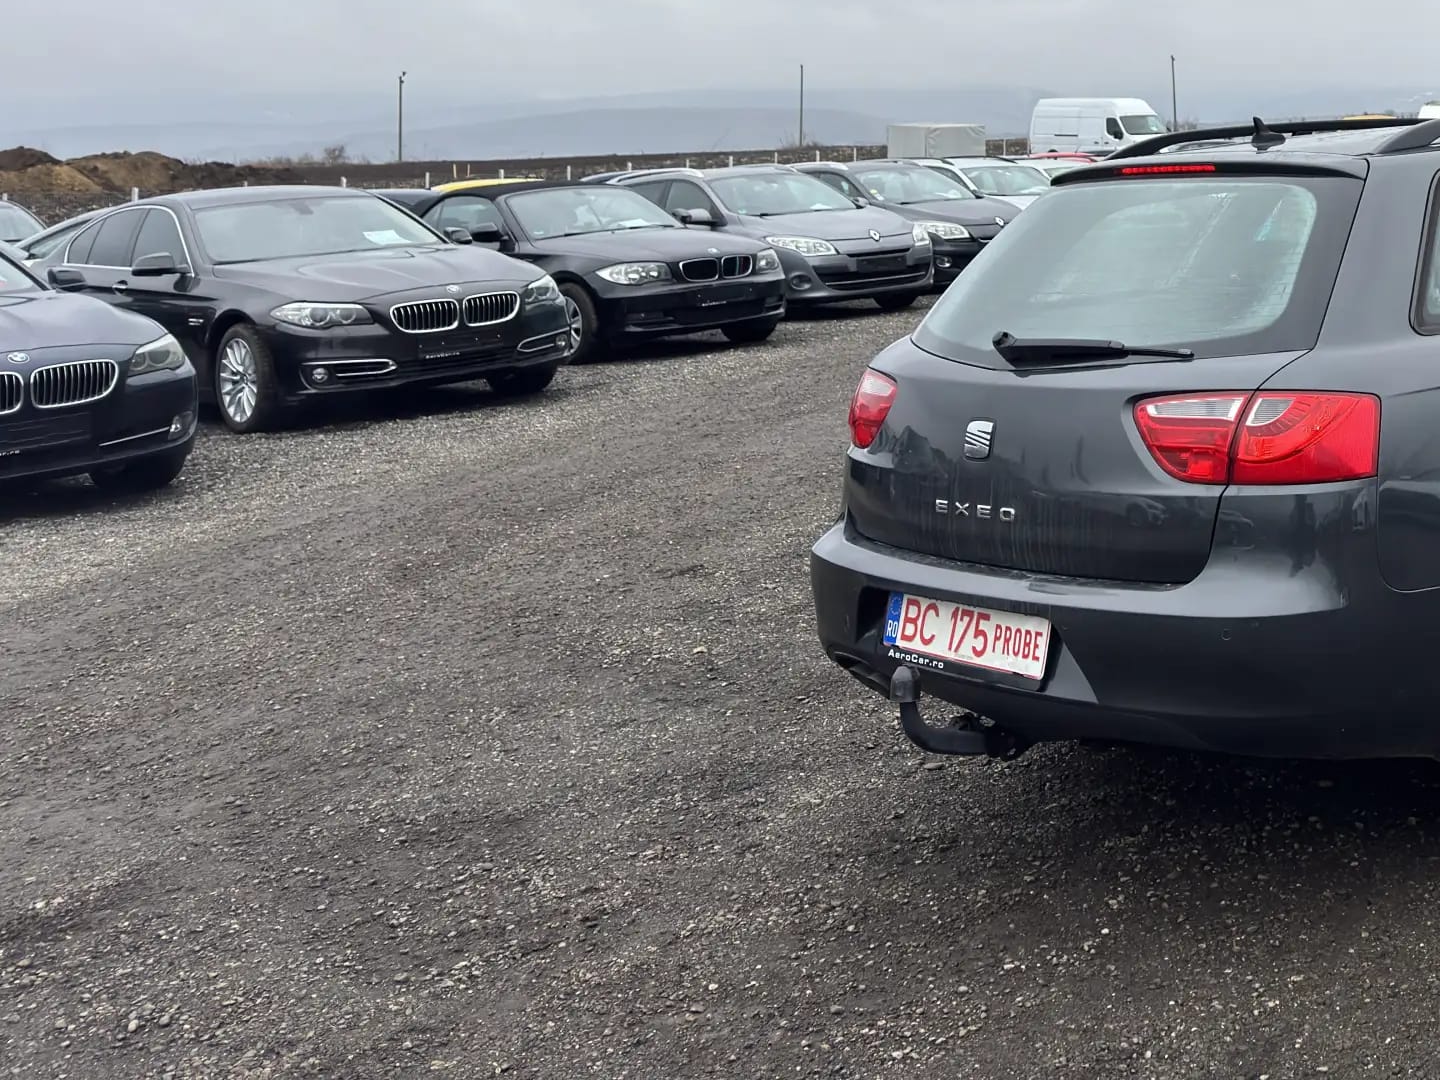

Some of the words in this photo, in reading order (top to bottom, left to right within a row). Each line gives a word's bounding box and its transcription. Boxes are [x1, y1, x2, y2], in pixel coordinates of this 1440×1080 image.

[935, 499, 1016, 522] EXEO
[886, 619, 899, 638] RO
[900, 598, 940, 646] BC
[948, 606, 991, 658] 175
[992, 623, 1043, 662] PROBE
[888, 649, 944, 669] AeroCar.ro
